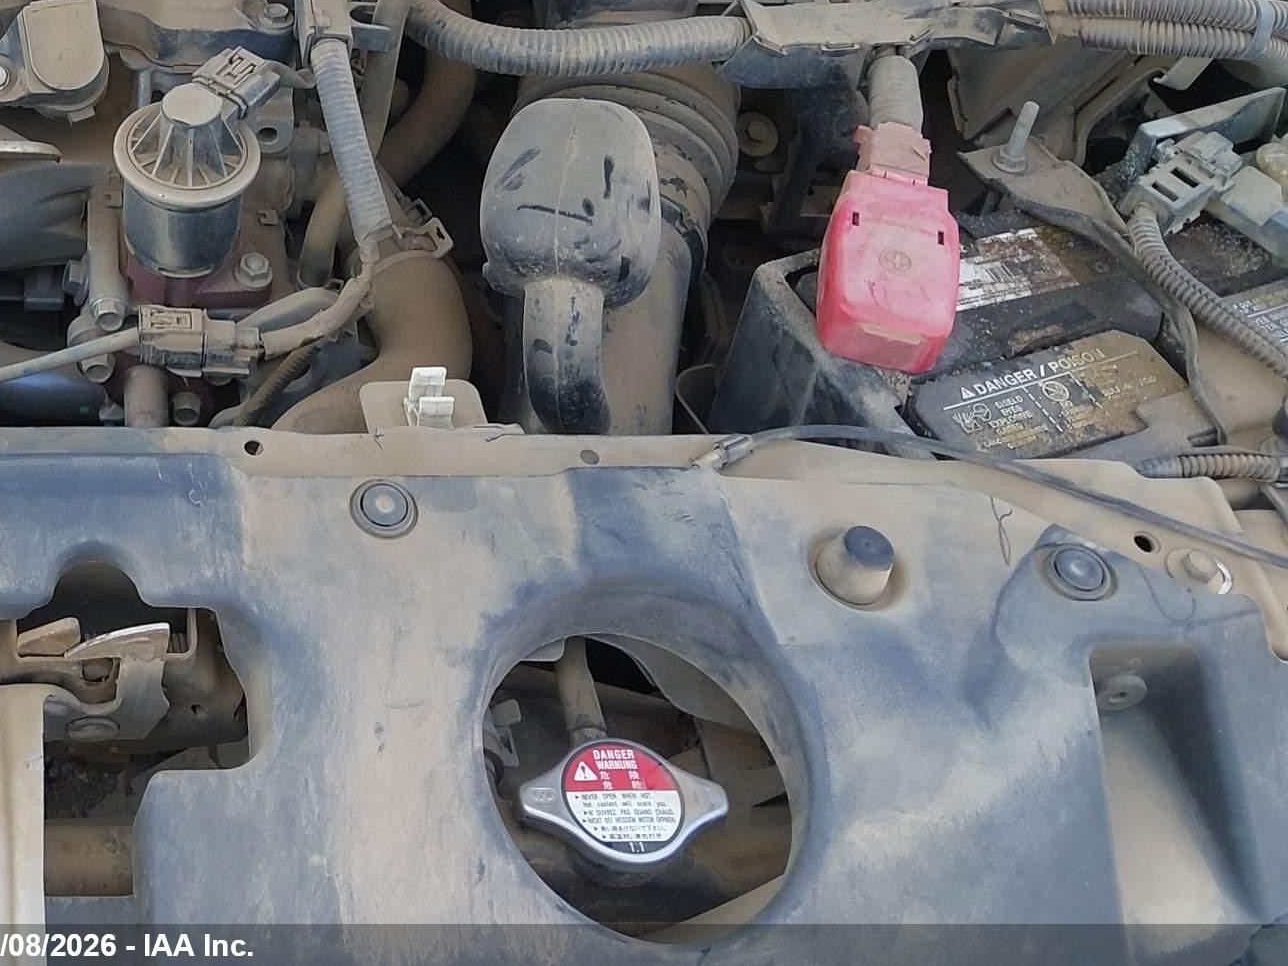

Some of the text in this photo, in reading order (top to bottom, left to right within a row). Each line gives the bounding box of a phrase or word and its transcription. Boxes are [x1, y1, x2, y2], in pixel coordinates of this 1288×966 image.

[973, 368, 1037, 395] DANGER
[1048, 348, 1106, 373] POISON
[592, 749, 635, 760] DANGER
[629, 842, 645, 852] 1.1
